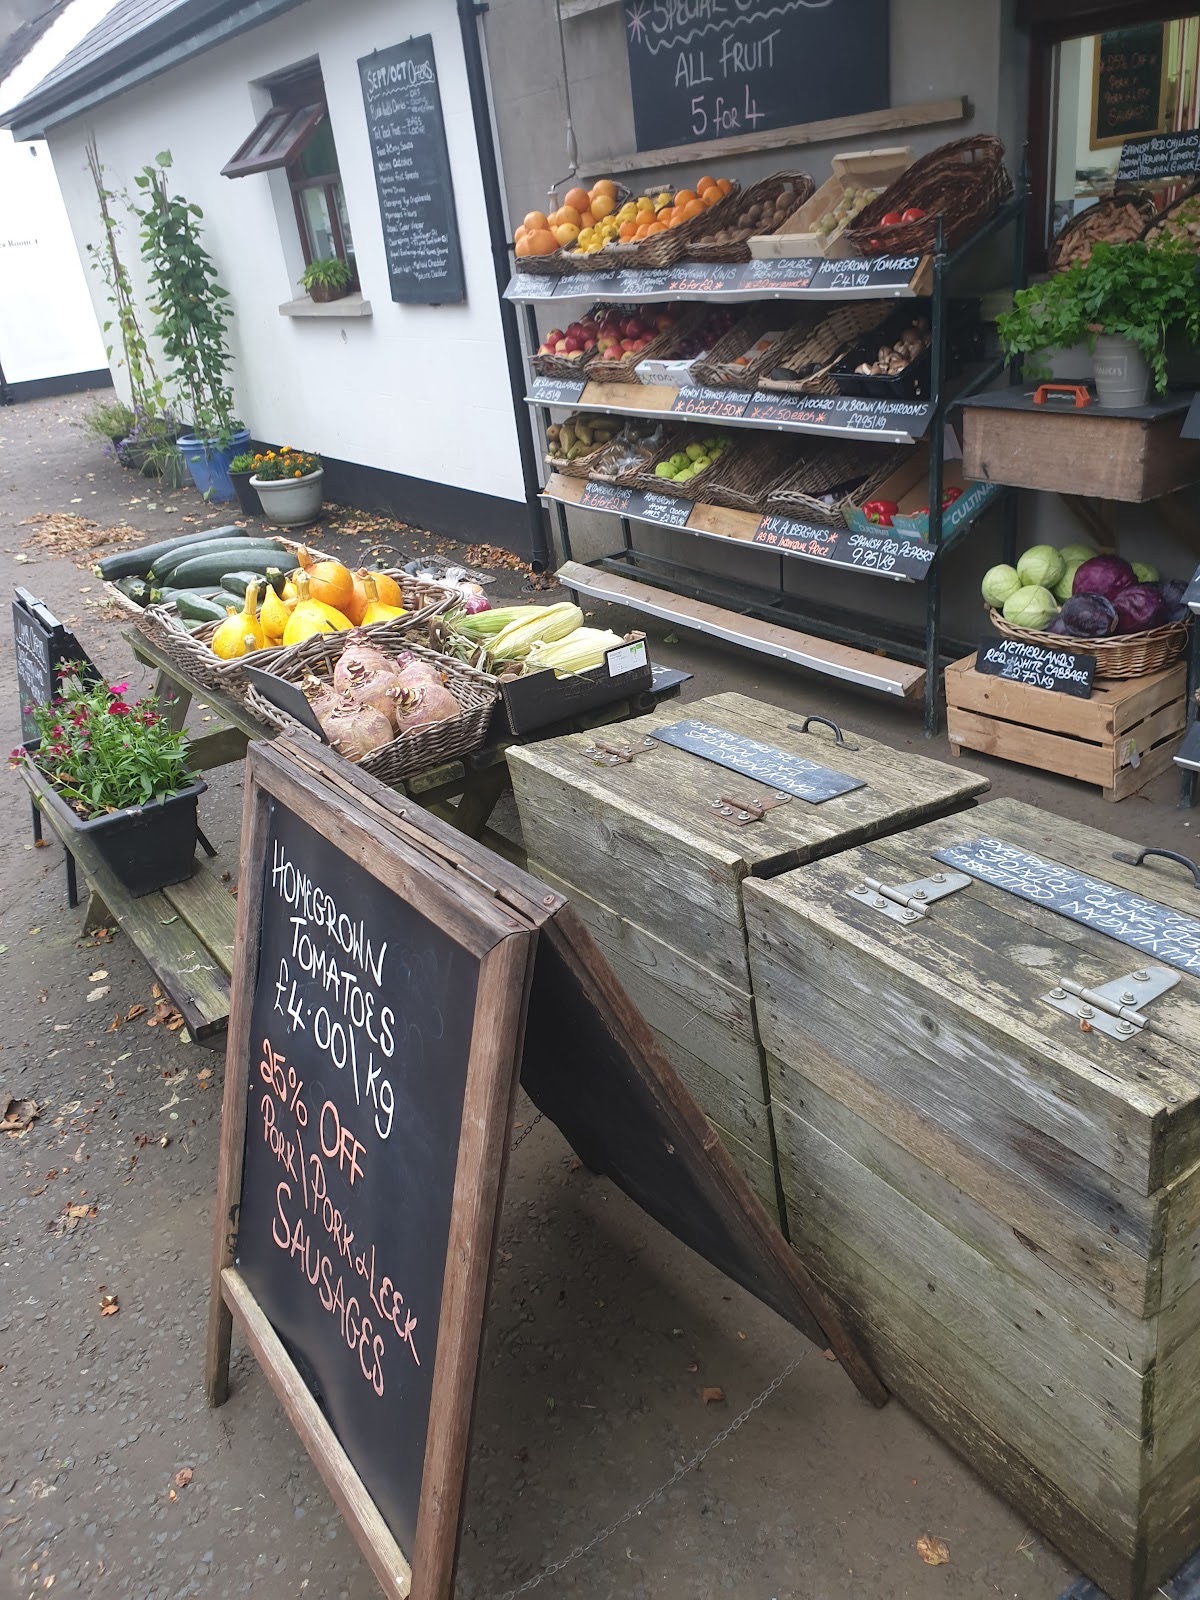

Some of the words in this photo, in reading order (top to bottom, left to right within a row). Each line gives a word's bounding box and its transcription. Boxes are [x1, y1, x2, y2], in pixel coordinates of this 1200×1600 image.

[675, 51, 714, 88] ALL
[719, 28, 781, 78] FRUIT
[691, 95, 707, 136] 5
[745, 84, 765, 130] 4
[818, 258, 875, 274] HOMEGROWN
[873, 254, 919, 272] TOMATOES
[679, 279, 687, 289] 6
[697, 279, 713, 290] £2
[686, 399, 695, 413] 6
[797, 395, 834, 410] AVOCADO
[836, 400, 848, 412] UK
[848, 399, 876, 413] BROWN
[874, 400, 928, 416] MUSHROOMS
[790, 411, 815, 422] each
[605, 497, 620, 510] £2
[766, 518, 780, 532] UK
[778, 521, 829, 542] AUBERGINES
[766, 533, 778, 544] PER
[808, 540, 829, 556] PRICE
[847, 534, 881, 551] SPANISH
[880, 539, 898, 555] RED
[898, 541, 935, 562] PEPPERS
[984, 648, 1006, 665] RED
[1014, 656, 1043, 673] WHITE
[1044, 664, 1089, 686] CABBAGE
[999, 640, 1075, 670] NETHERLANDS
[690, 722, 719, 733] BAG
[685, 730, 757, 757] POTATOES
[710, 749, 816, 793] BALLYLAGAN
[979, 839, 1024, 858] BAG
[975, 849, 1079, 892] POTATOES
[1085, 879, 1124, 896] PER
[272, 840, 387, 987] HOMEGROWN
[1085, 895, 1165, 930] SARPO
[290, 917, 395, 1057] TOMATOES
[260, 1038, 307, 1126] 25%
[319, 1101, 366, 1185] OFF
[272, 1182, 385, 1397] SAUSAGES
[369, 1244, 421, 1366] LEEK
